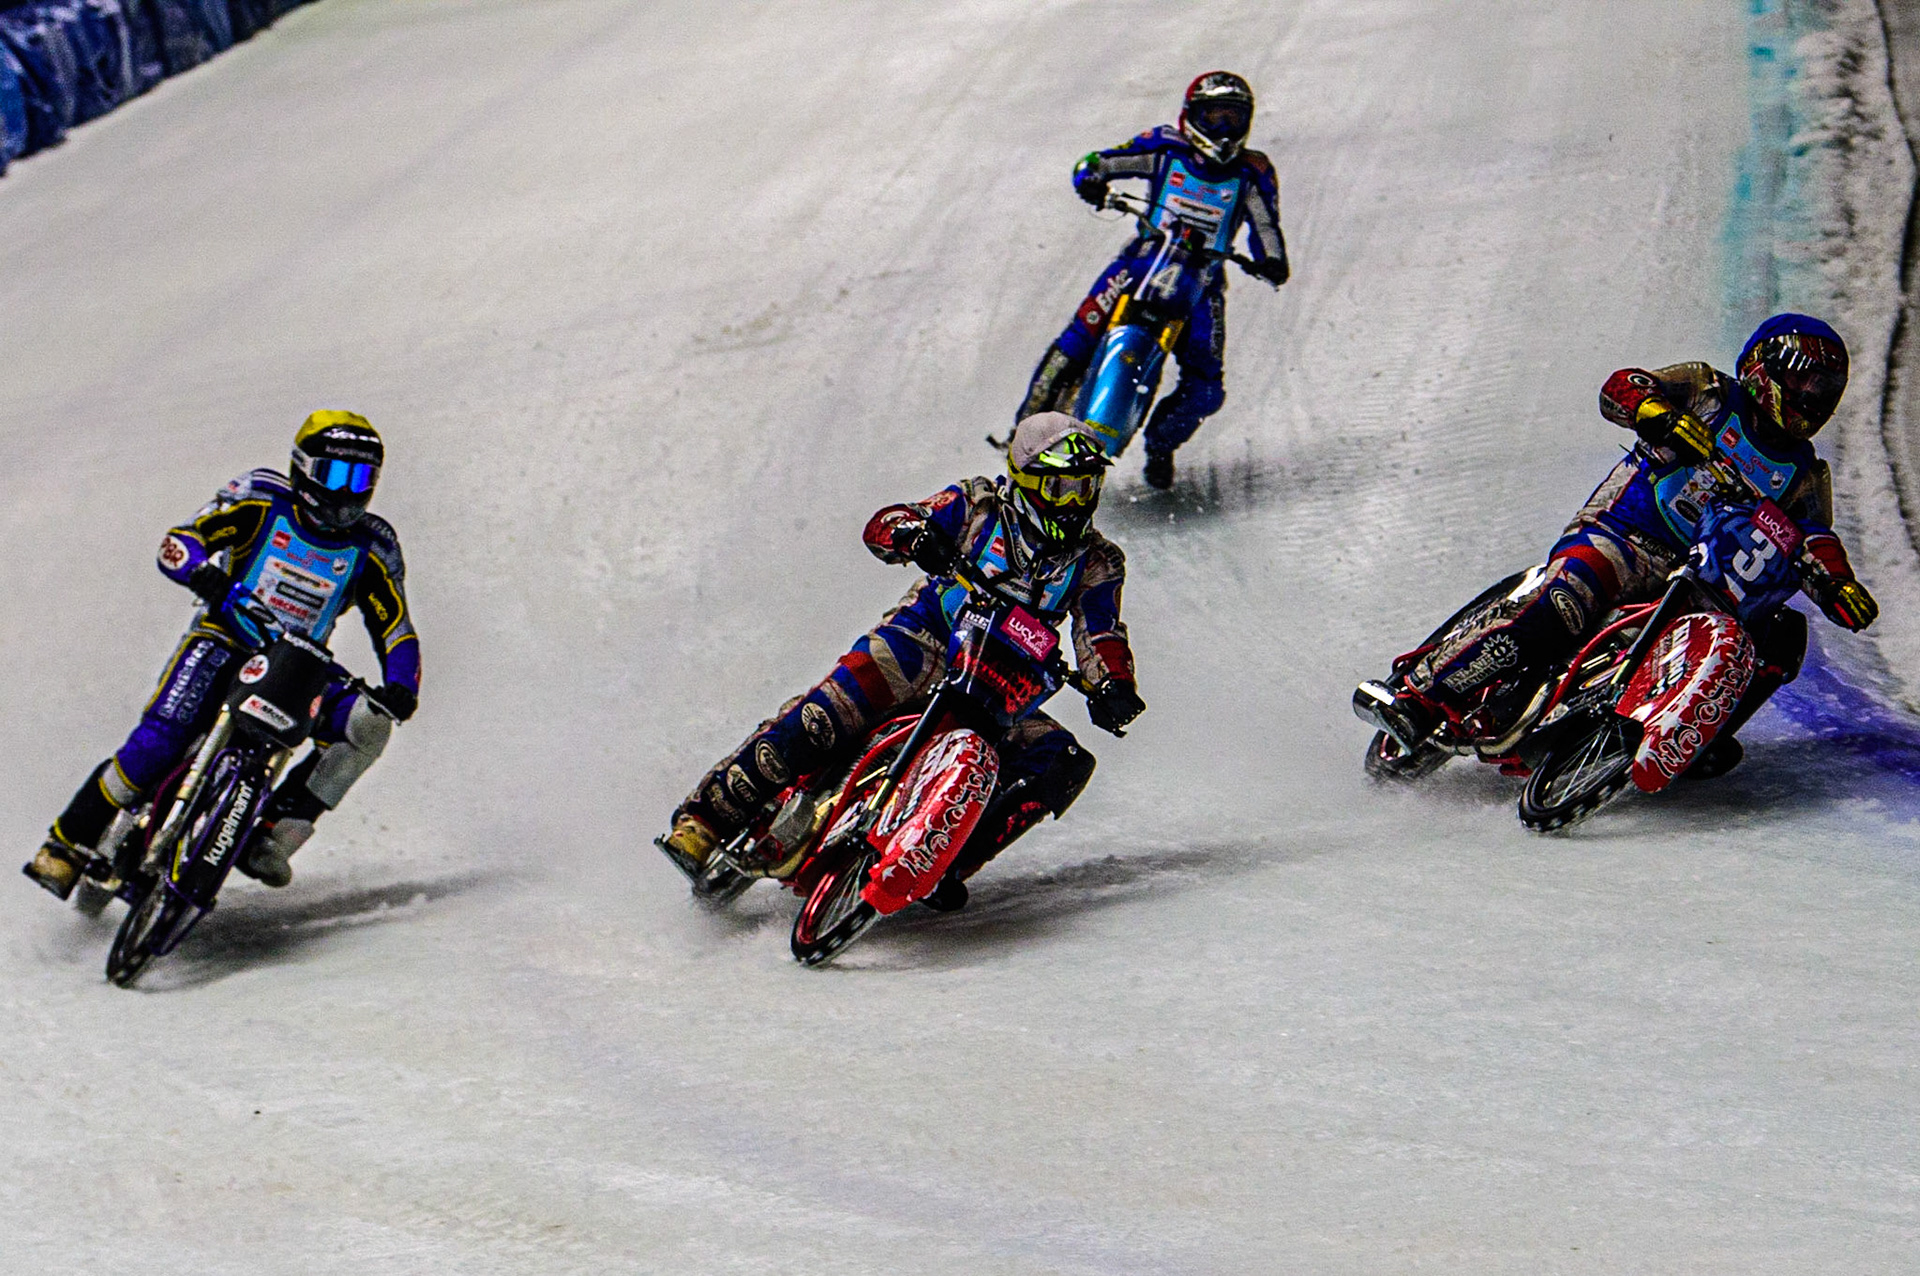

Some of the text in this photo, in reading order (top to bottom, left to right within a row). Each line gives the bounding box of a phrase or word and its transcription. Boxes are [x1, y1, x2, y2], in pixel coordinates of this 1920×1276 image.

[1151, 262, 1183, 299] 4
[1758, 510, 1783, 535] LUCY
[1732, 528, 1778, 581] 3
[1008, 617, 1036, 640] LUCY
[203, 780, 255, 867] kugelmann
